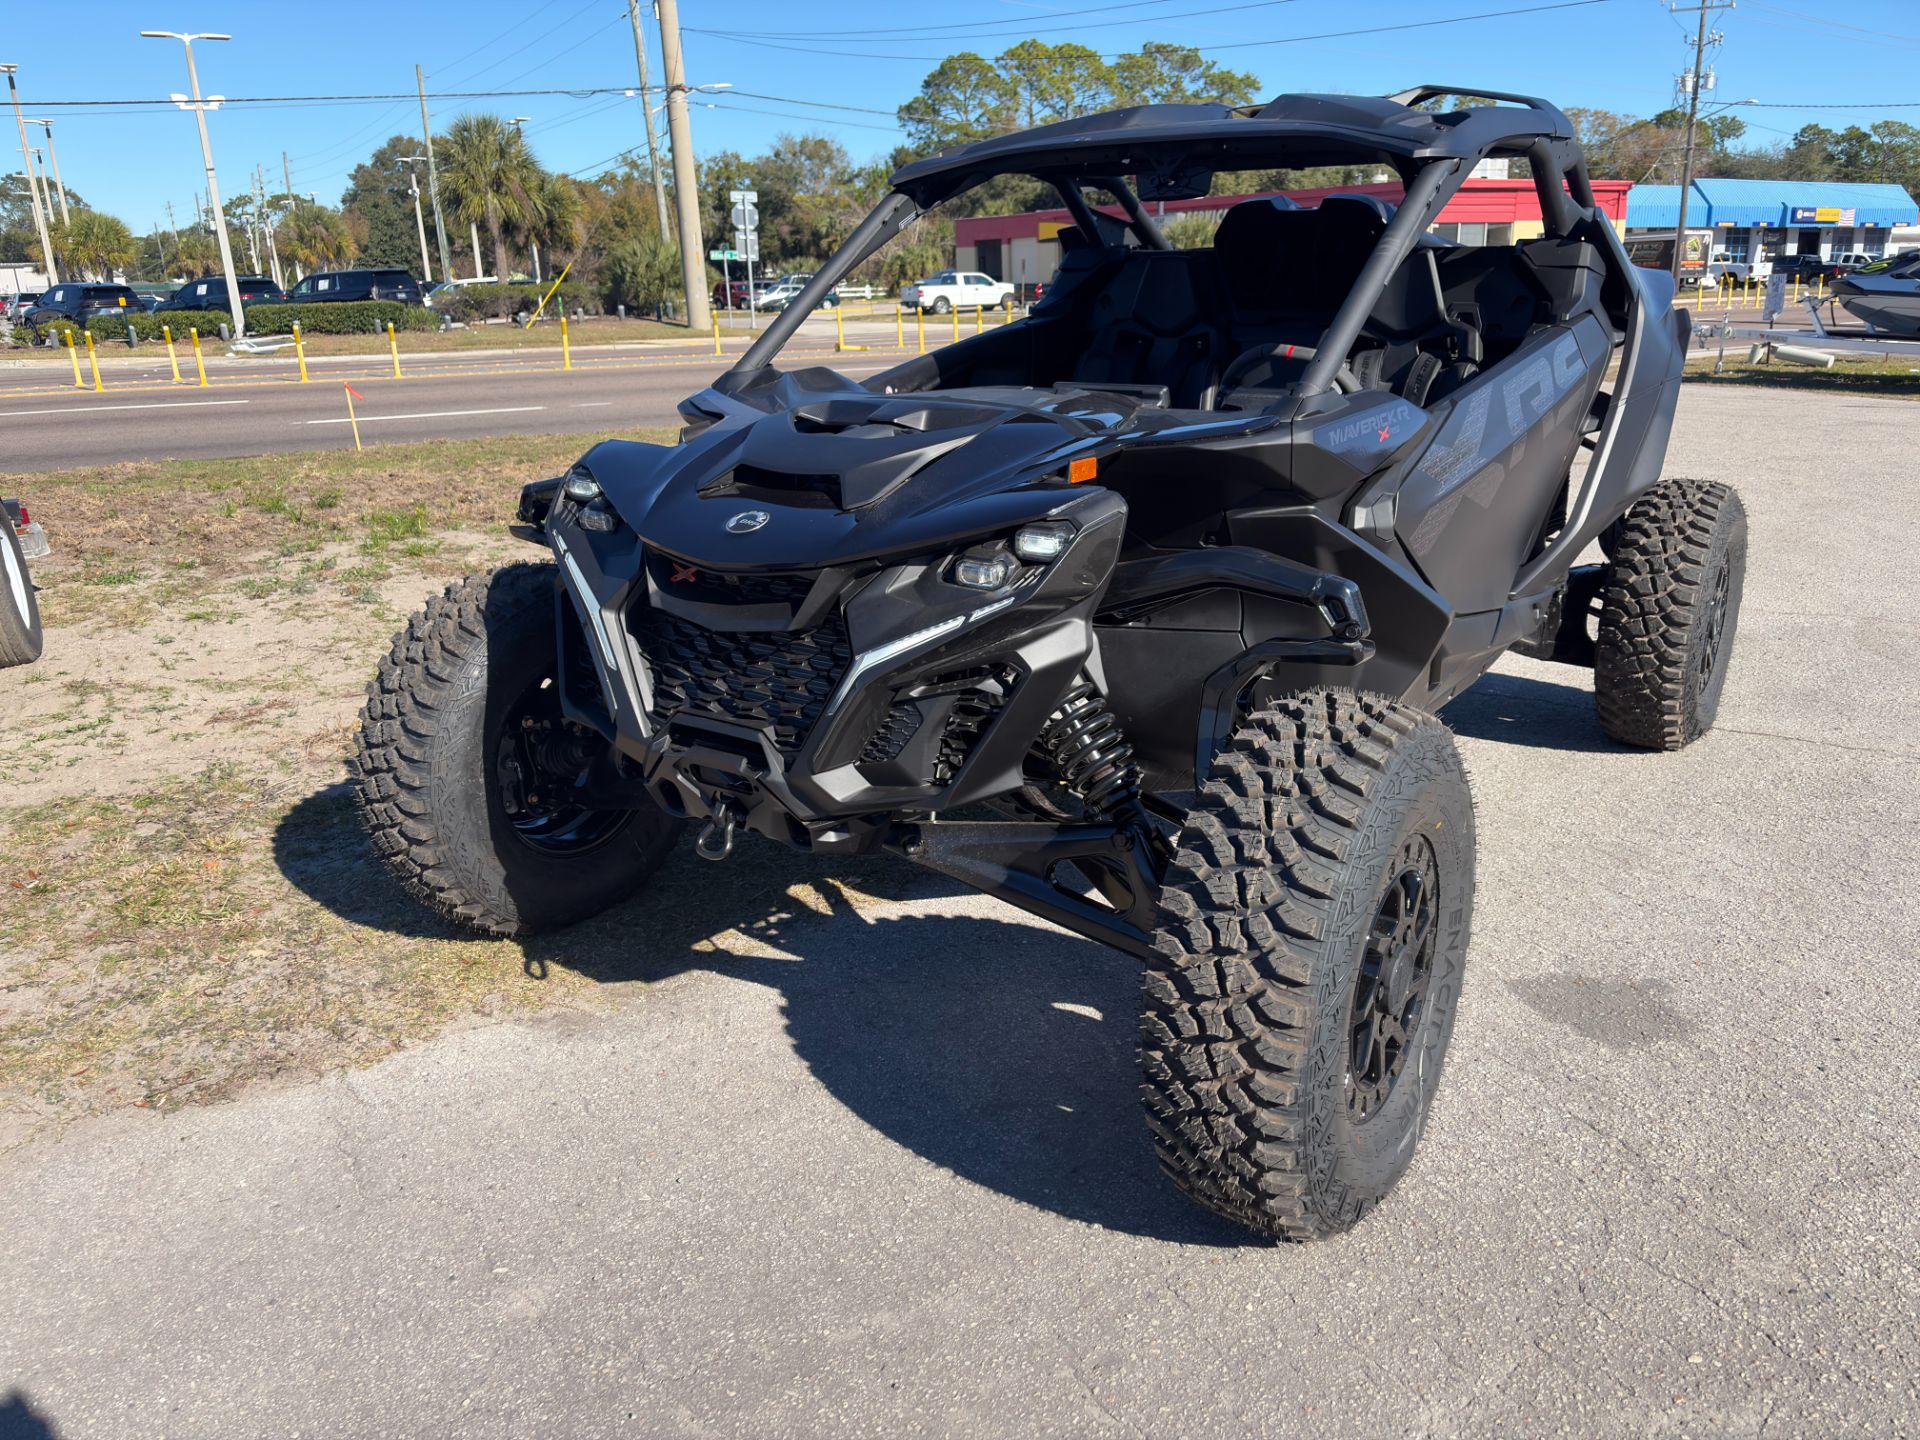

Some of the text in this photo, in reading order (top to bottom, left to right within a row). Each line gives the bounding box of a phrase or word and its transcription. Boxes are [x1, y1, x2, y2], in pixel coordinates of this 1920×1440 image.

[1328, 405, 1411, 447] MAVERICK R
[1424, 886, 1465, 1065] TENACITY
